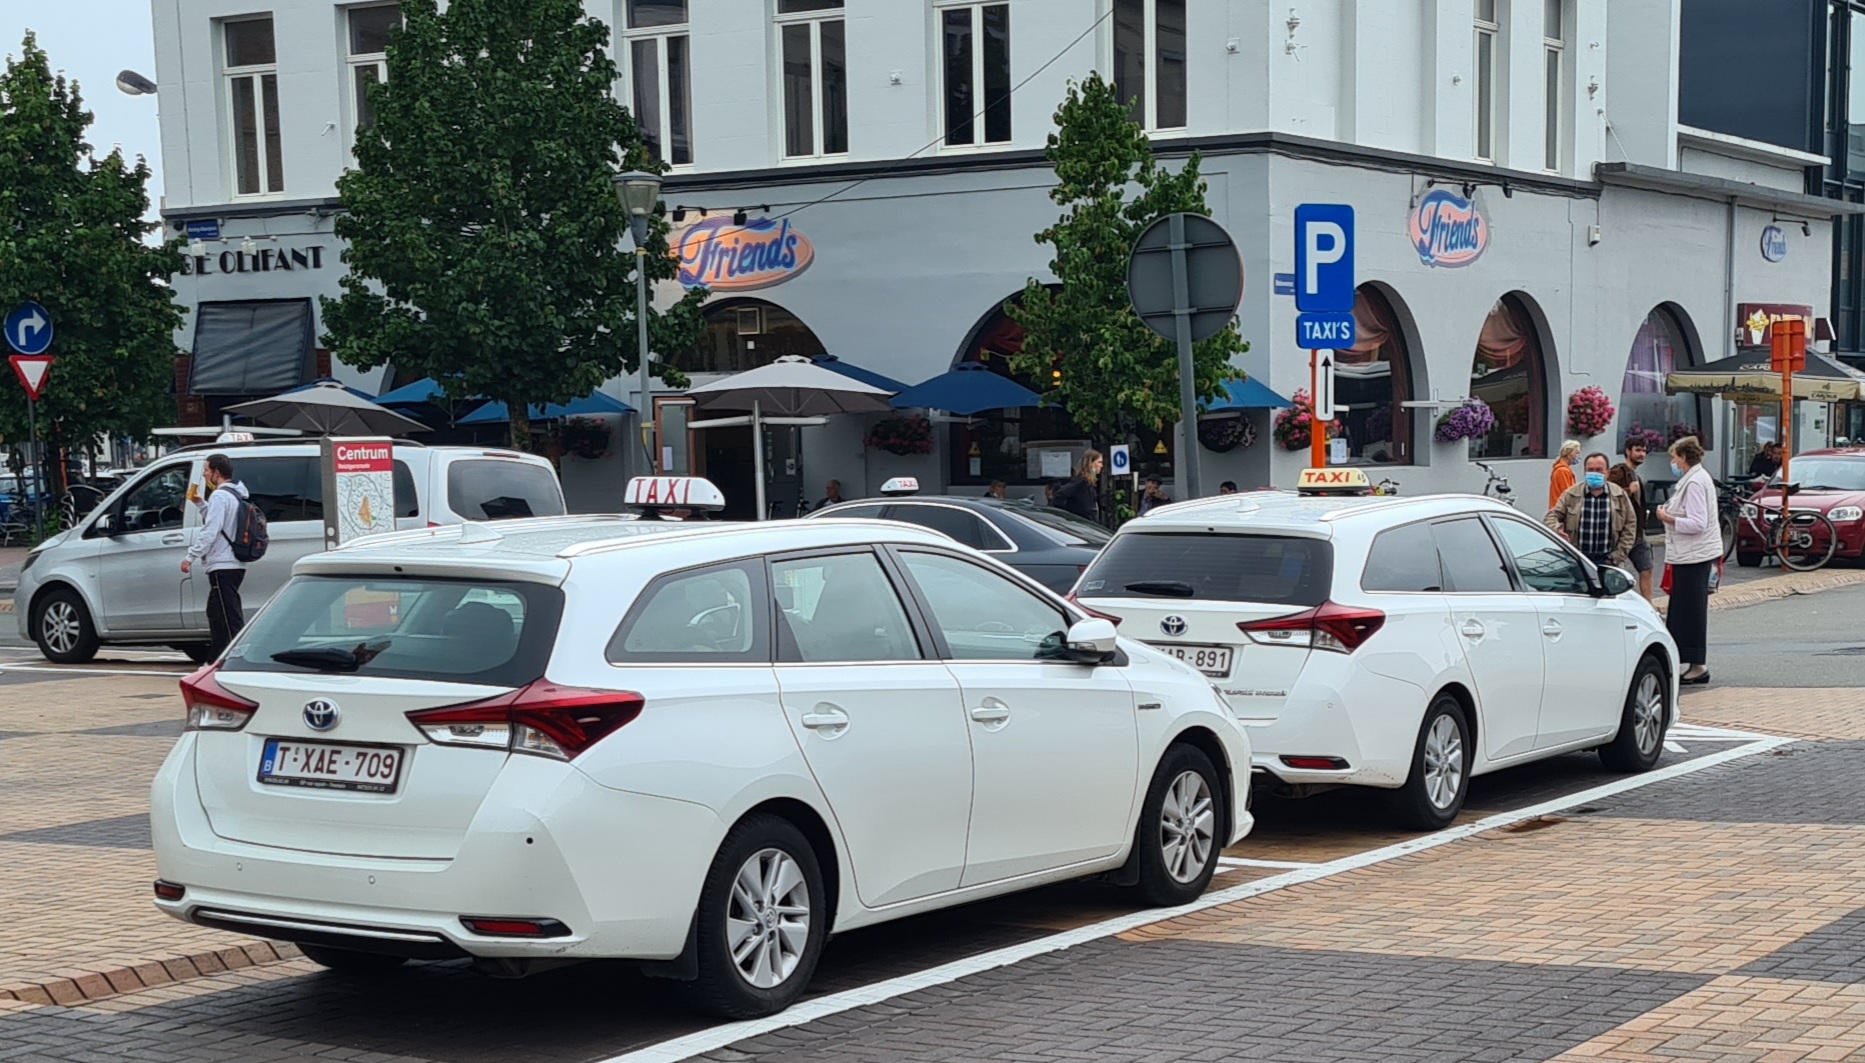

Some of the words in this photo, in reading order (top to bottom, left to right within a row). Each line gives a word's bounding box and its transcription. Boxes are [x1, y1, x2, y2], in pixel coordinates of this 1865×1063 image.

[1418, 190, 1480, 259] Friends
[219, 246, 324, 274] OLIFANT
[677, 216, 799, 287] Friends
[1306, 221, 1346, 294] P
[1303, 321, 1350, 340] TAXI'S
[337, 446, 389, 460] Centrum
[1305, 472, 1350, 483] TAXI
[635, 479, 691, 504] TAXI
[264, 760, 272, 772] B
